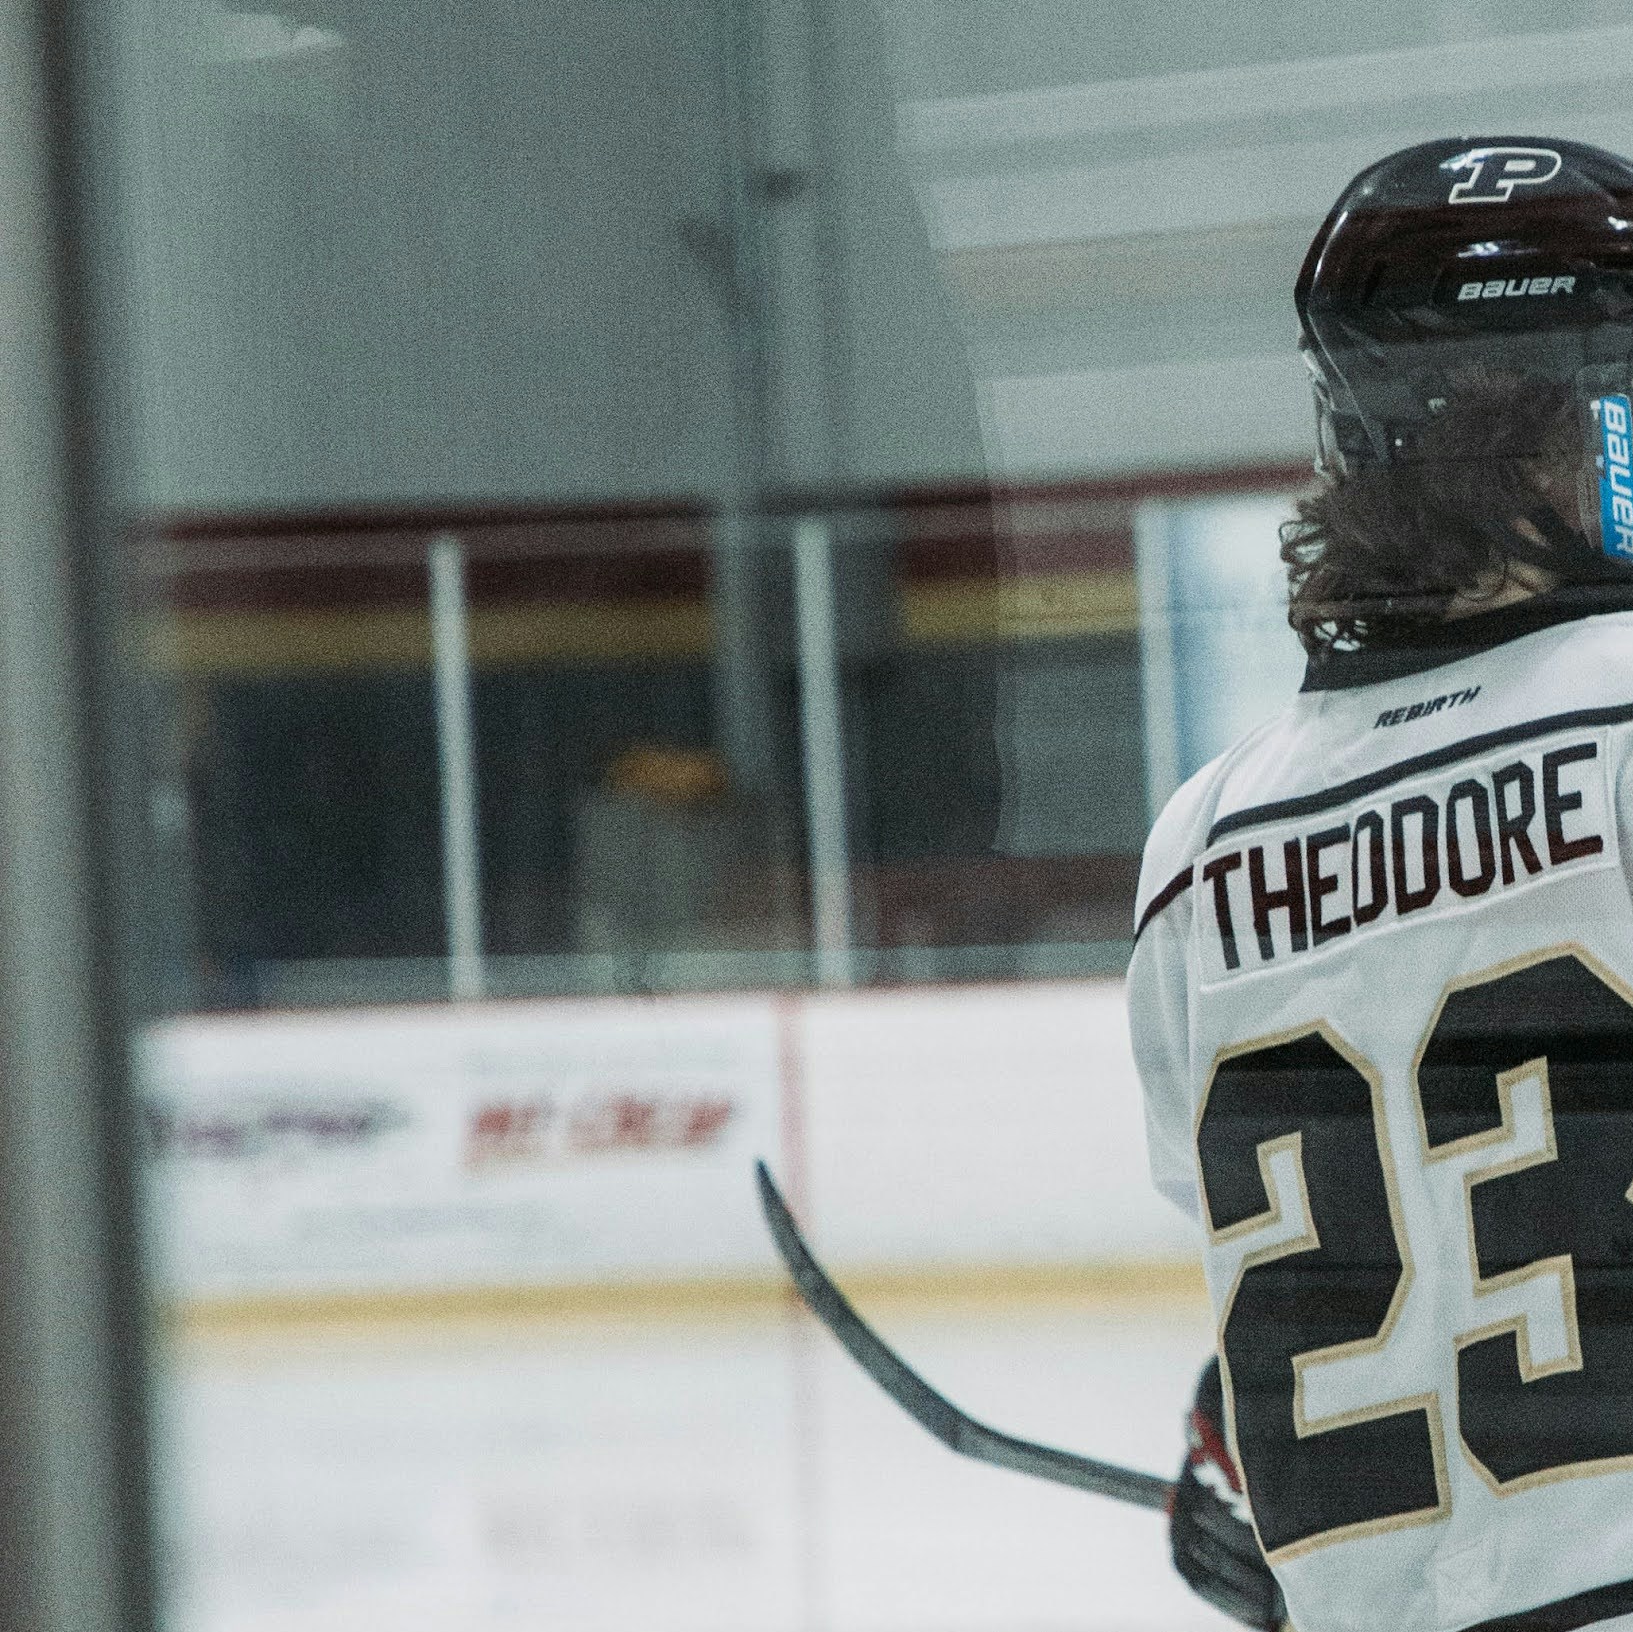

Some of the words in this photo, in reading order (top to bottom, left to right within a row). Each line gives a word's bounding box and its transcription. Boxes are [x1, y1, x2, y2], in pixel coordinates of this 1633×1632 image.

[1447, 146, 1563, 205] P
[1457, 274, 1576, 302] BAUER
[1373, 686, 1482, 730] REBIRTH
[1202, 741, 1604, 971] THEODORE
